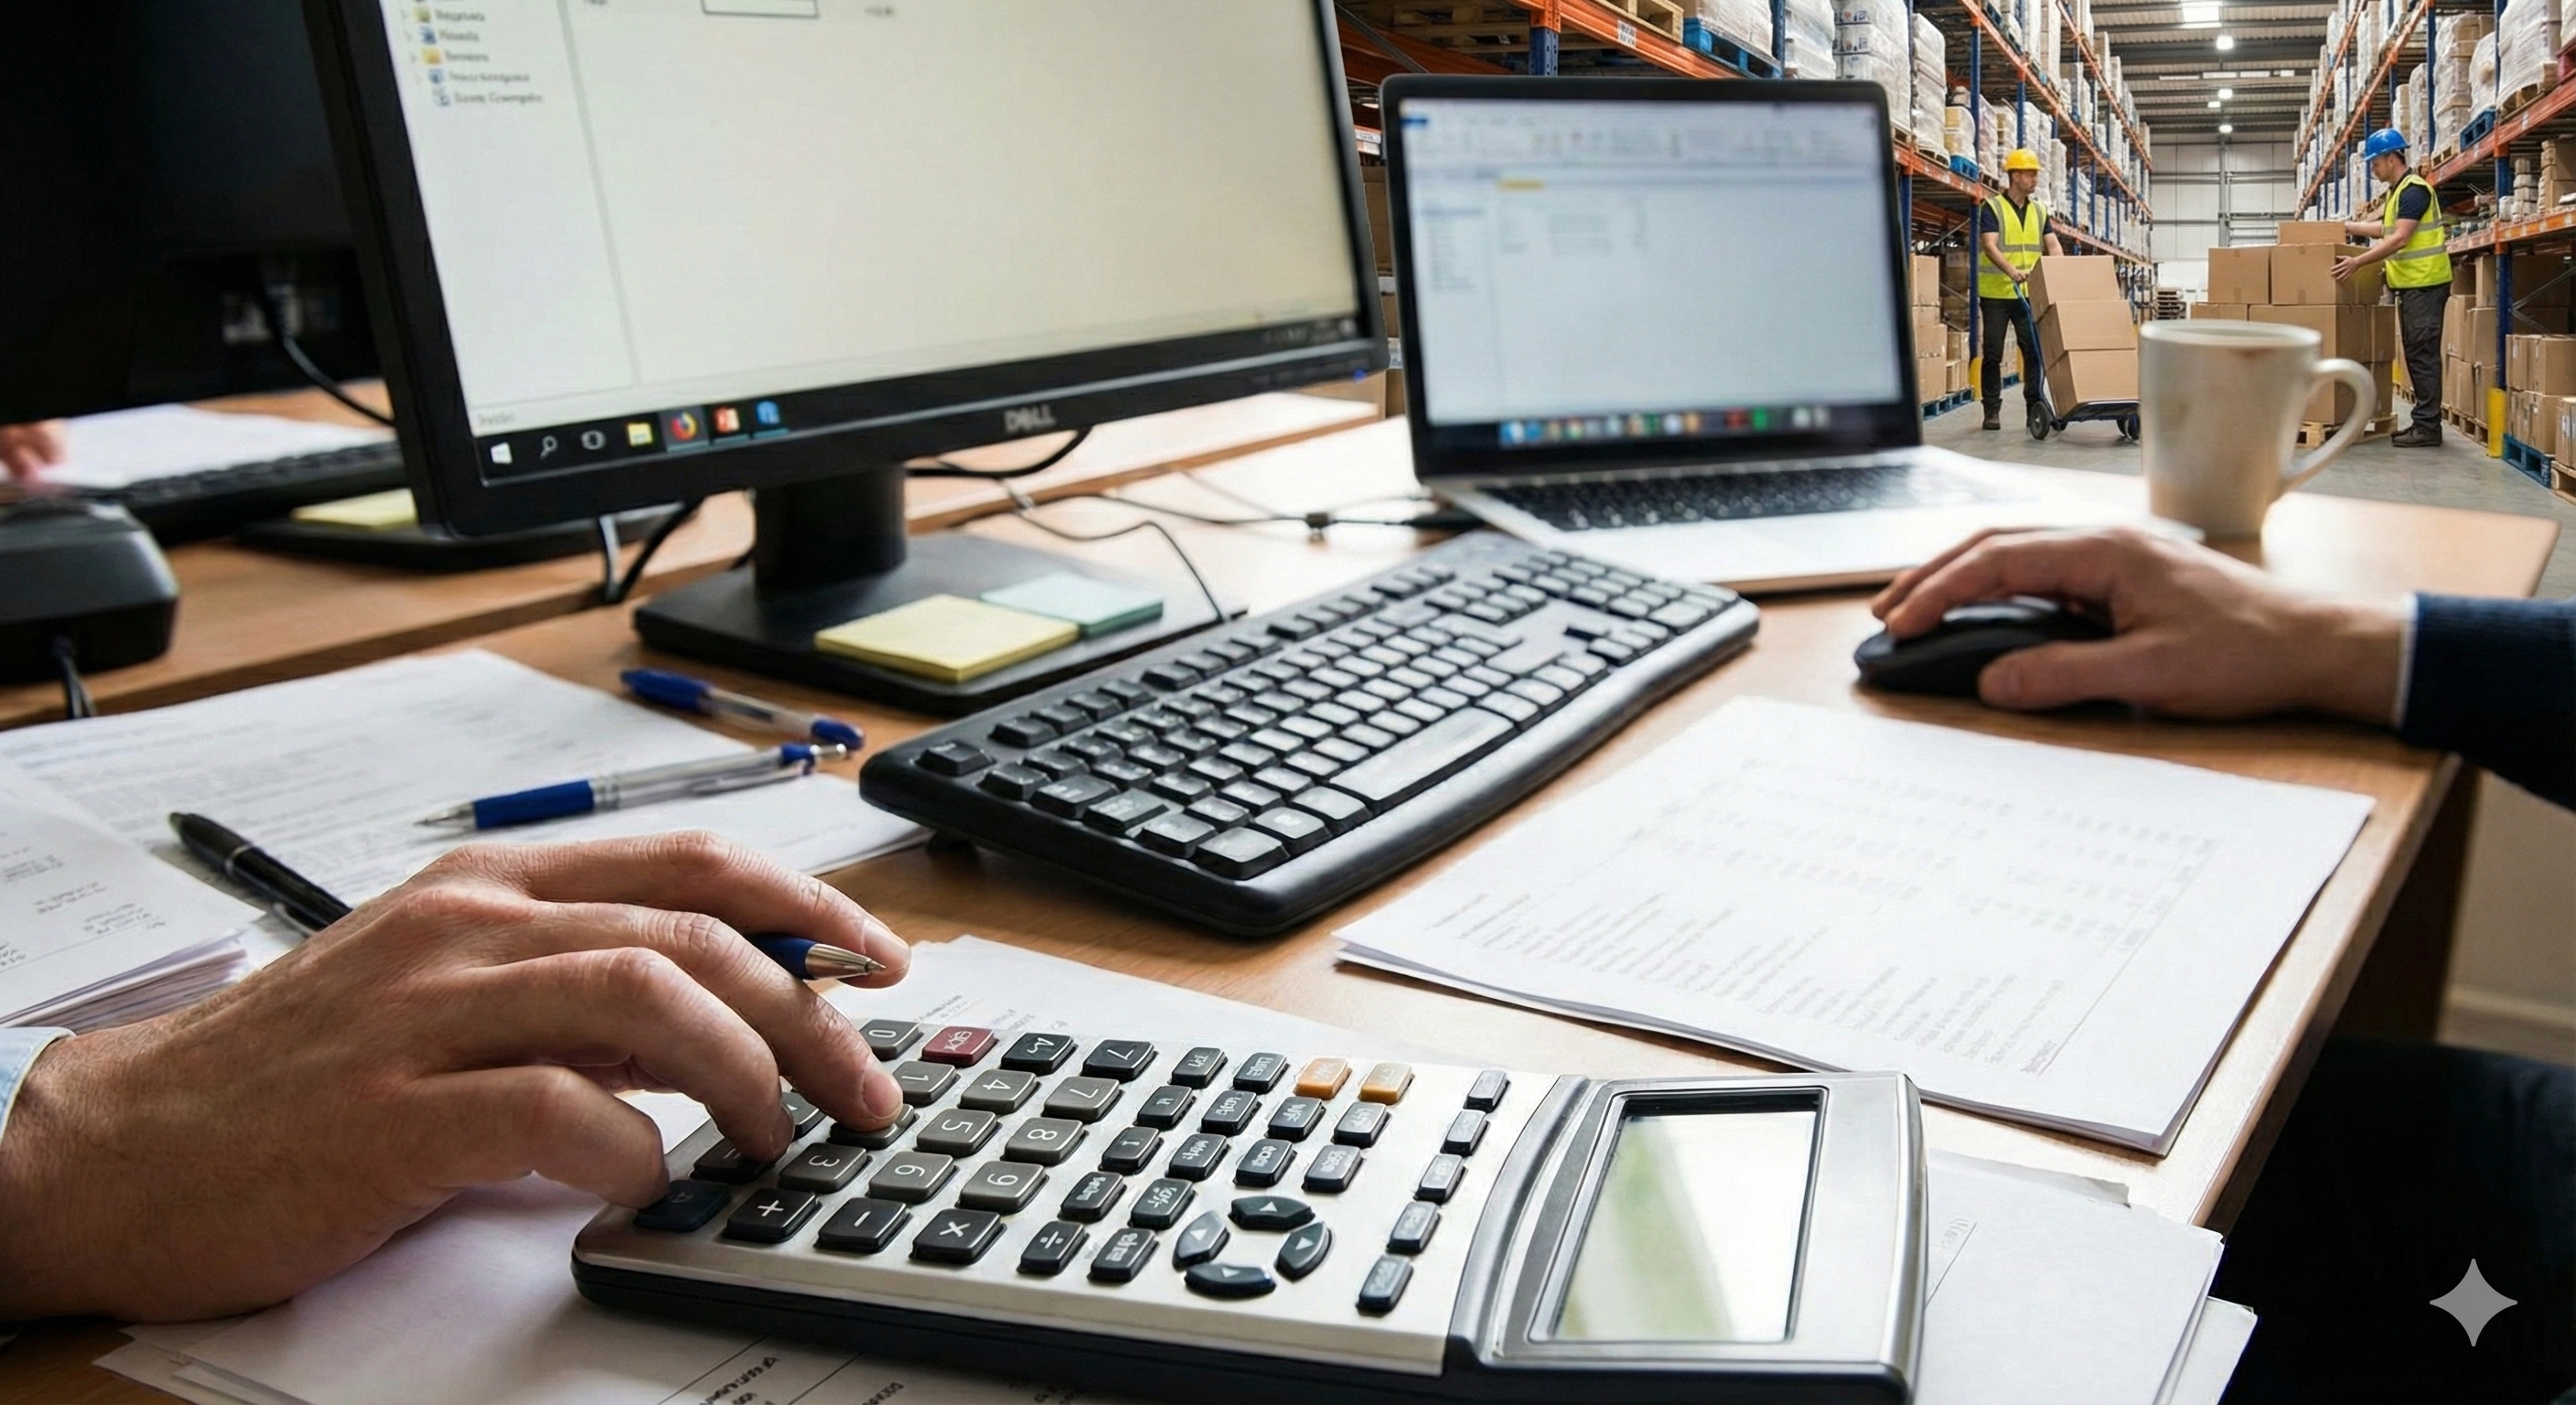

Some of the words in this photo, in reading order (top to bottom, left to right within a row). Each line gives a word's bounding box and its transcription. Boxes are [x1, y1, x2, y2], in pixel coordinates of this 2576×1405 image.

[869, 1029, 897, 1038] 0
[901, 1074, 929, 1082] 1
[982, 1078, 1011, 1090] 4
[1069, 1089, 1099, 1099] 7
[941, 1119, 974, 1133] 5
[1027, 1129, 1057, 1141] 8
[809, 1154, 841, 1167] 3
[895, 1164, 926, 1178] 6
[987, 1173, 1018, 1186] 9
